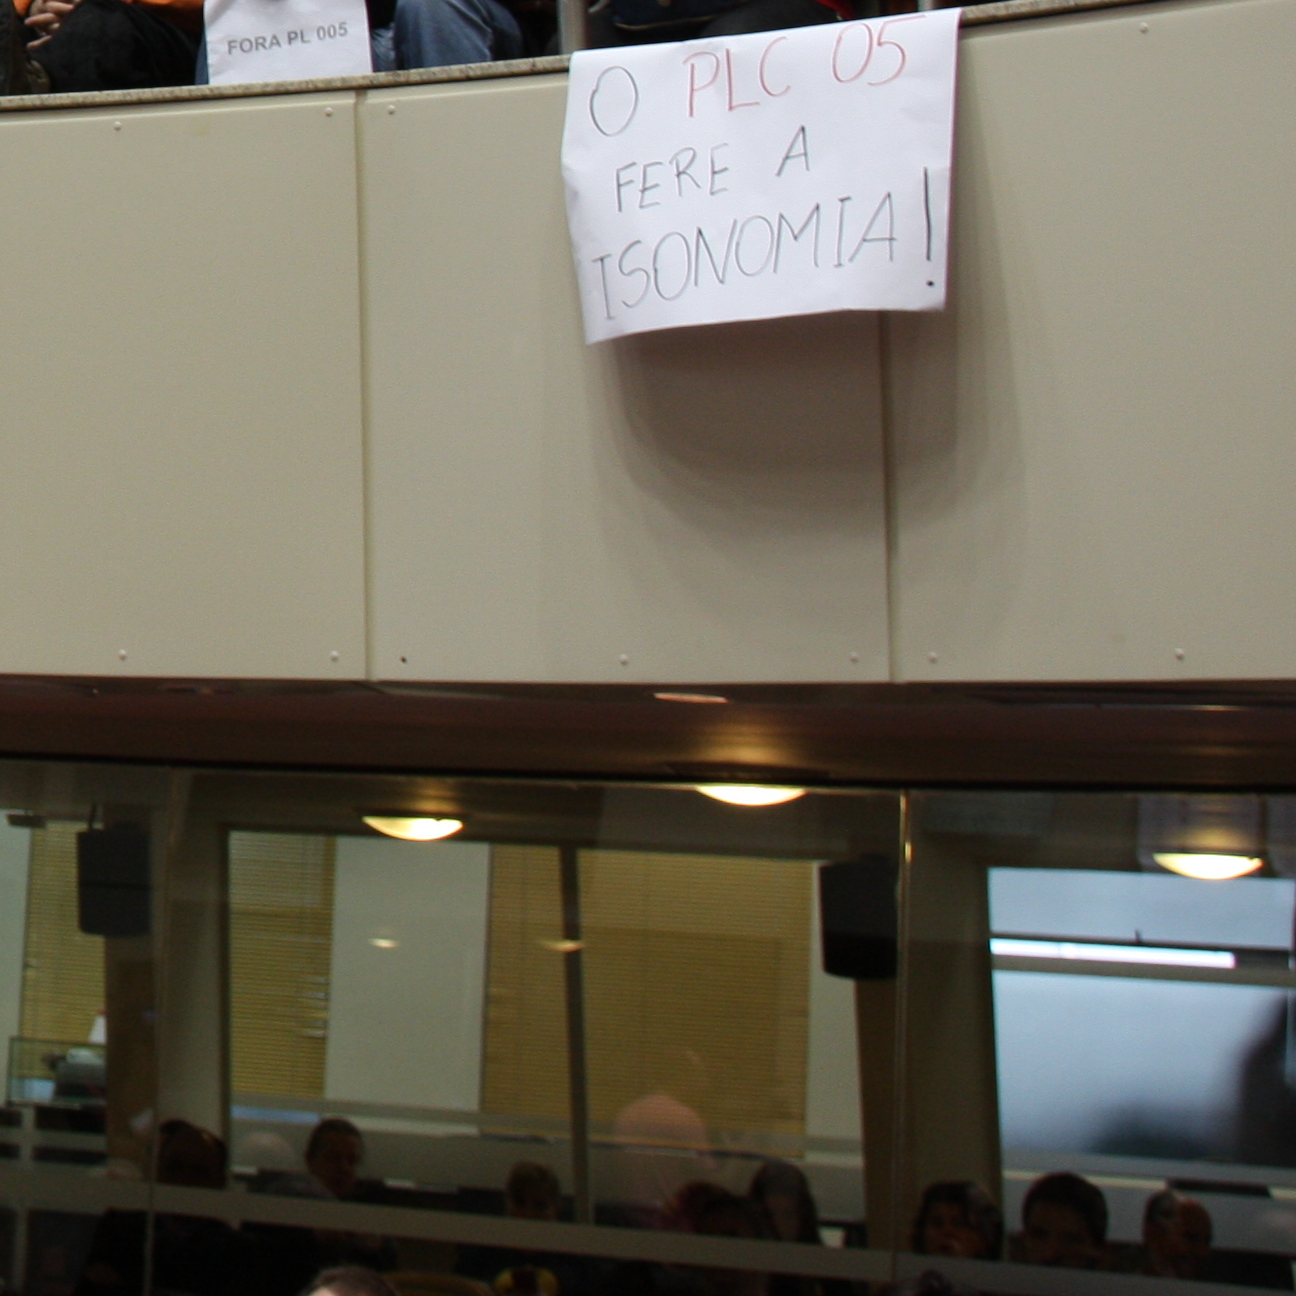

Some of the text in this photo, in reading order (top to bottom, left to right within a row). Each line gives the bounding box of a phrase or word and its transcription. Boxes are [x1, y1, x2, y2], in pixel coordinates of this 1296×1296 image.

[227, 22, 348, 55] FORA PL 005
[589, 14, 927, 136] O PLC 05
[615, 125, 810, 212] FERE A
[591, 166, 935, 321] ISONOMIA!
